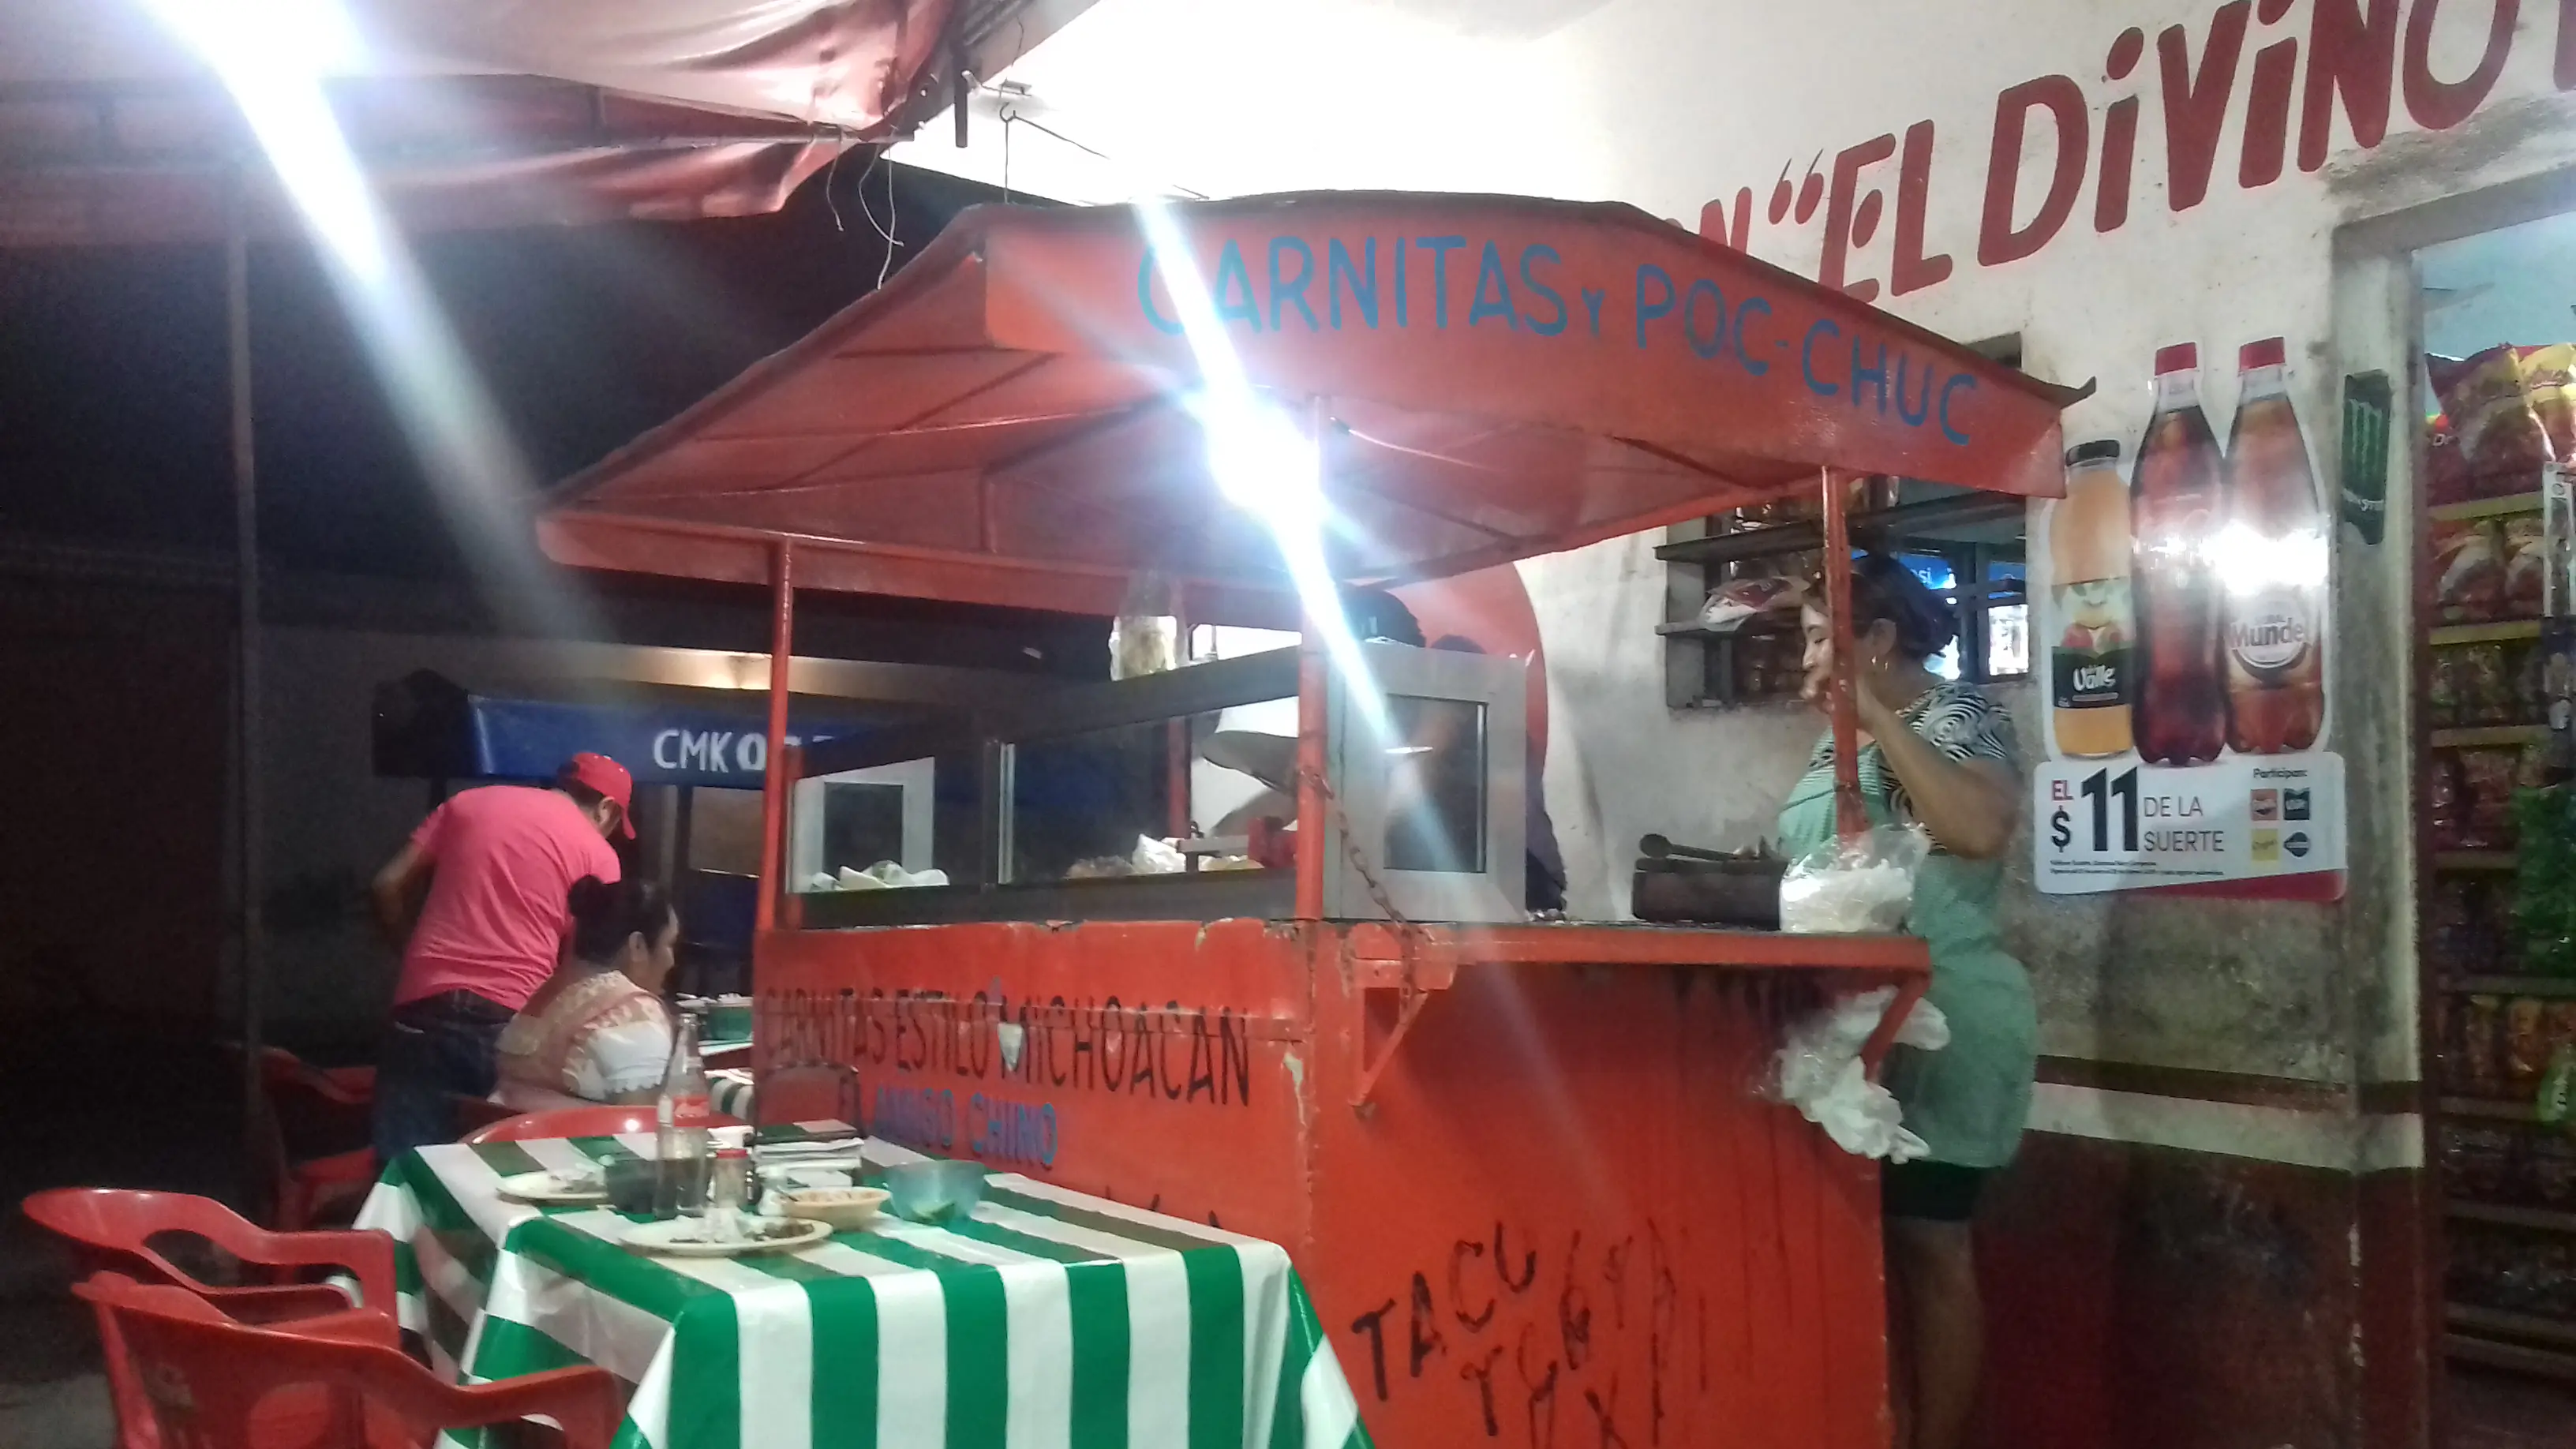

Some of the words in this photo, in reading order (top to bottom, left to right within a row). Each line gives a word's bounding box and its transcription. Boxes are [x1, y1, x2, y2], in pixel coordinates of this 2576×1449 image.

[1137, 234, 1569, 337] CARNITAS
[1635, 263, 1979, 447] POC-CHUC
[2052, 780, 2073, 800] EL
[2144, 796, 2171, 817] DE
[2178, 796, 2203, 816] LA
[2144, 830, 2224, 852] SUERTE
[969, 1092, 1058, 1169] CHINO
